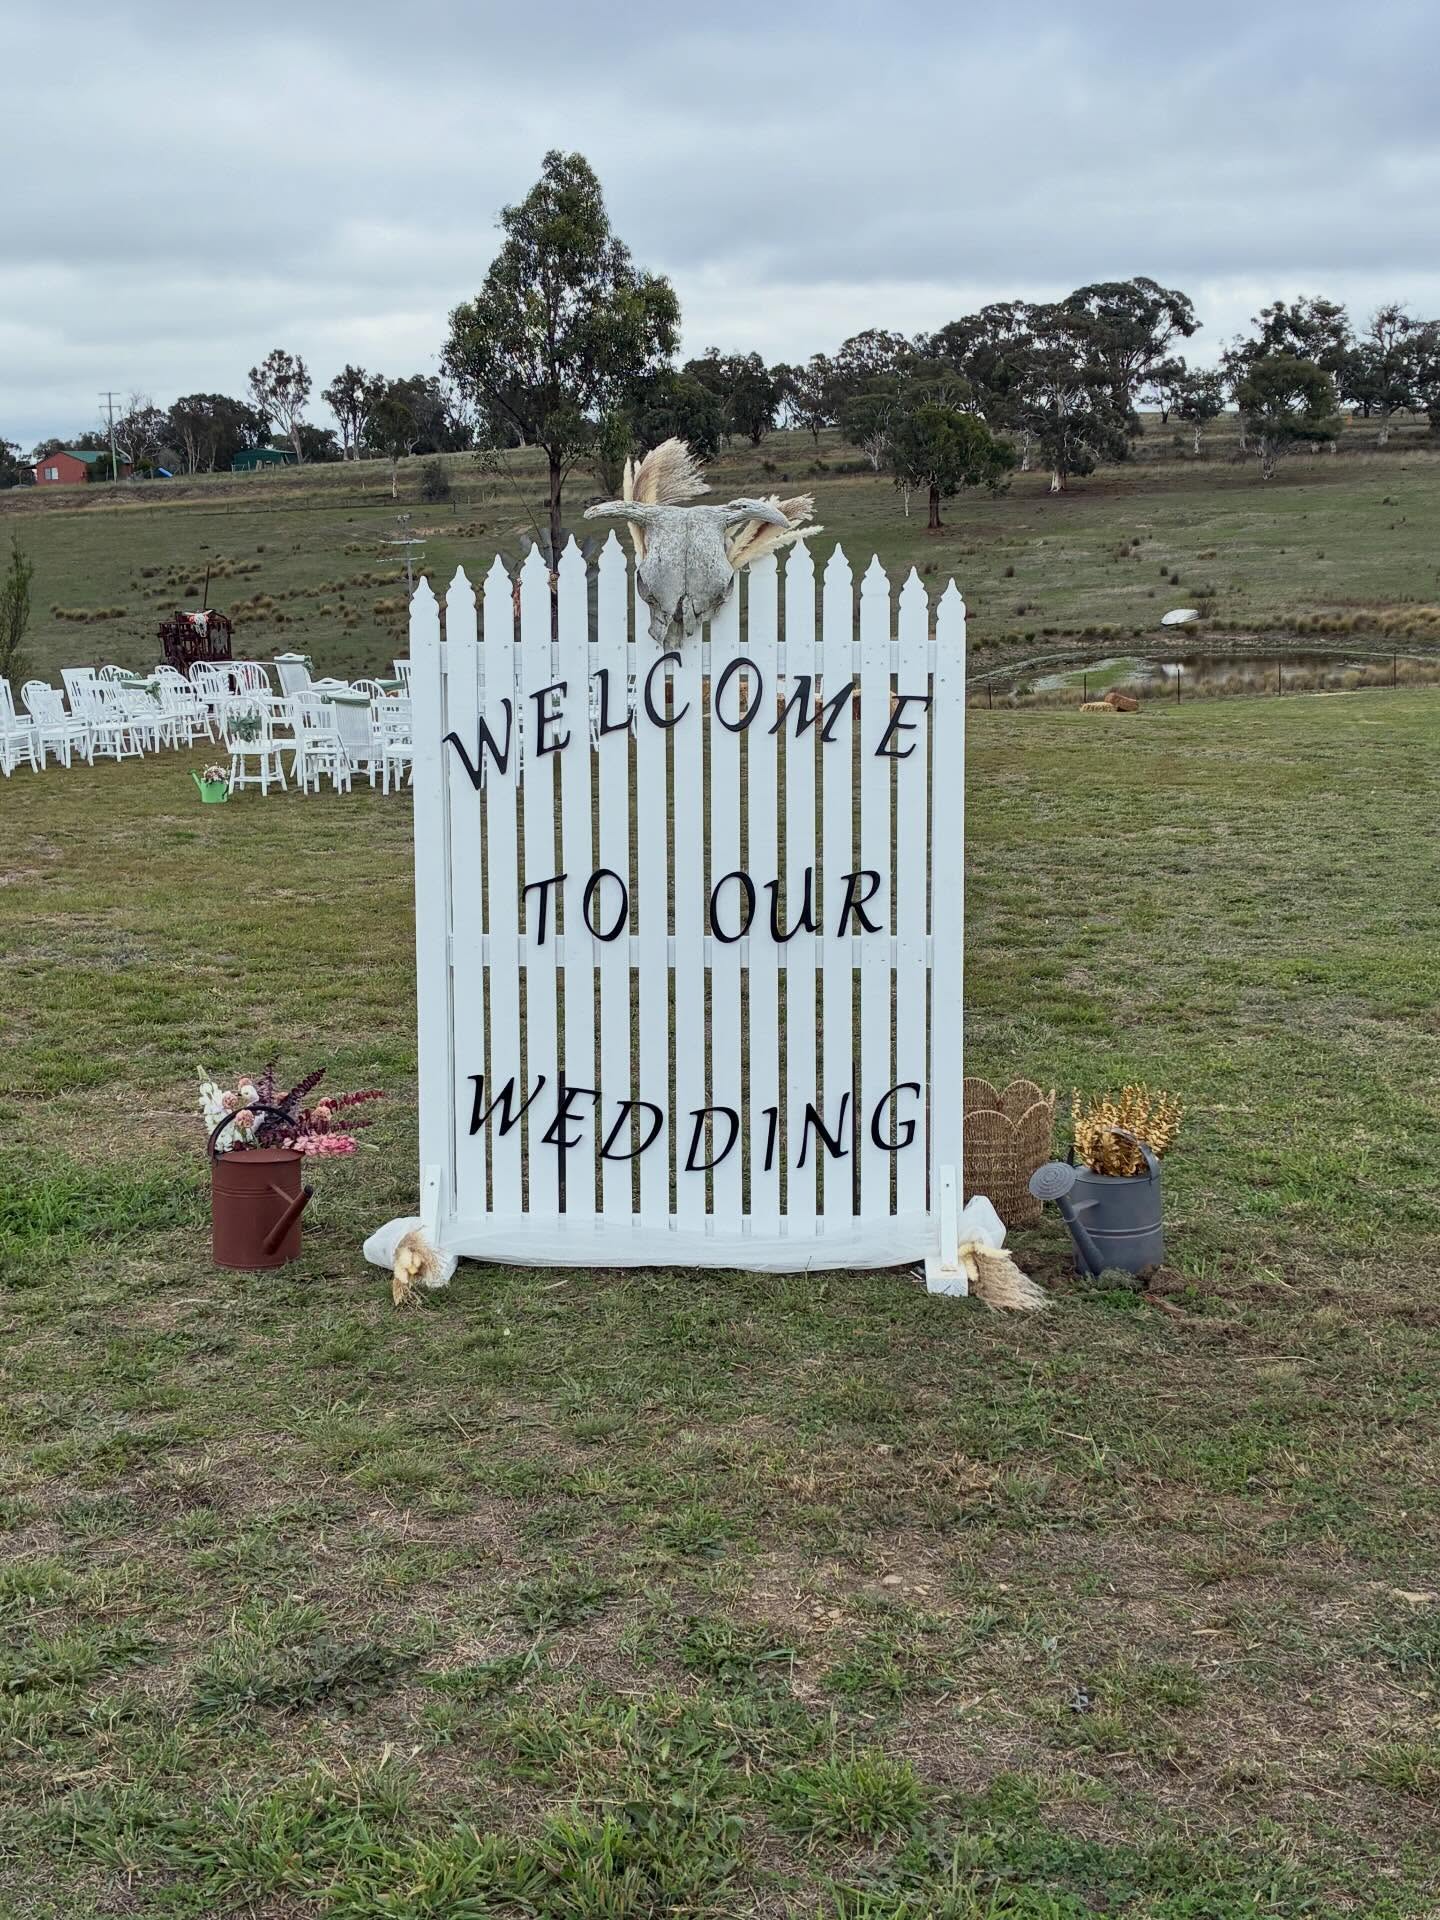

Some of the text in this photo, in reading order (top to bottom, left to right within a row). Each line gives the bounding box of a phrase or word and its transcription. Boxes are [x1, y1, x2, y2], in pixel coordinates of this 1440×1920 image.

[442, 651, 933, 791] WELCOME
[522, 867, 883, 945] TO OUR
[466, 1073, 921, 1172] WEDDING
